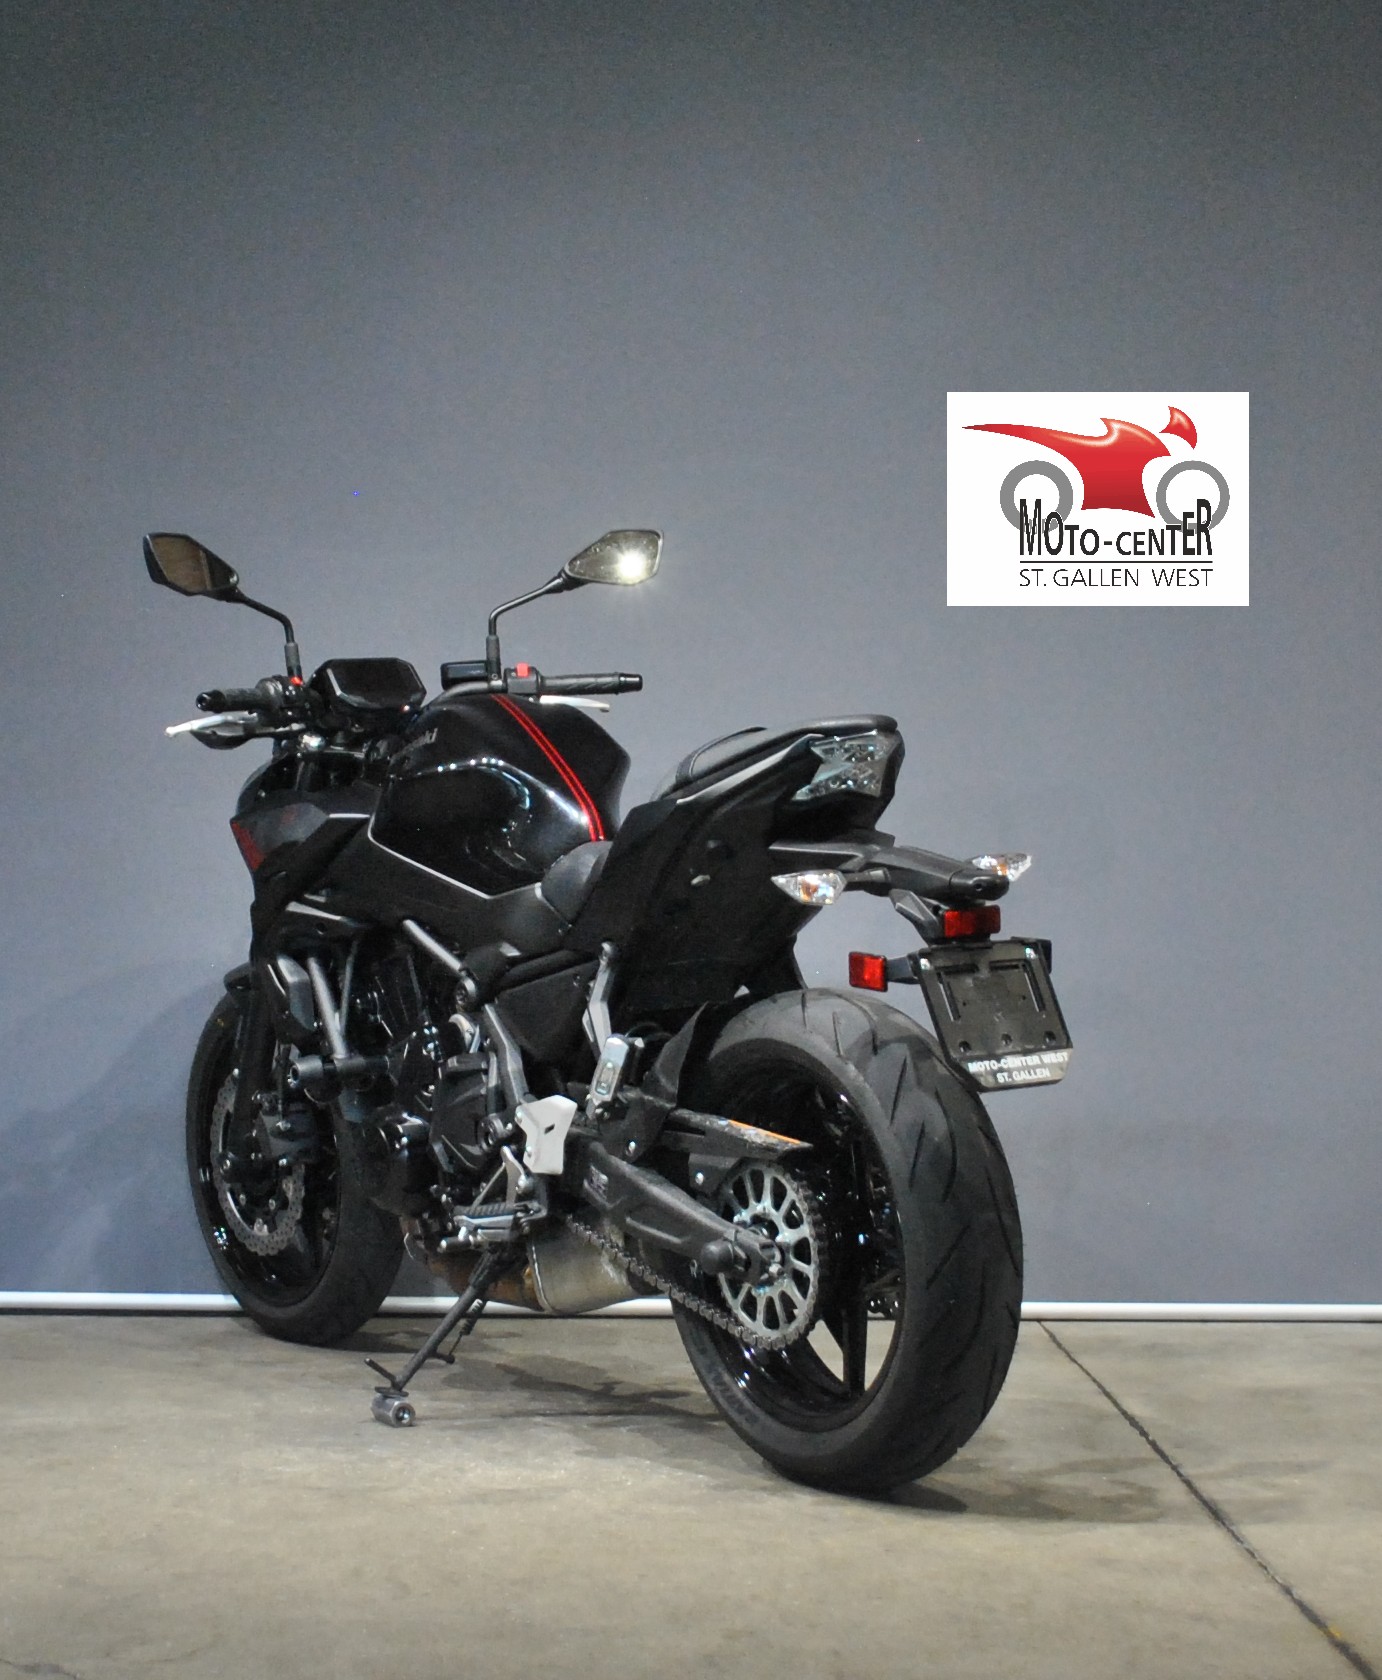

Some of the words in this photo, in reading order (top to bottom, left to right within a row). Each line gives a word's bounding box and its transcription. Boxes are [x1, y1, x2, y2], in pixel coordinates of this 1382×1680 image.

[968, 1055, 1041, 1073] MOTO-CENTER
[1041, 1052, 1069, 1064] WEST
[996, 1072, 1013, 1083] ST.
[1012, 1067, 1051, 1081] GALLEN
